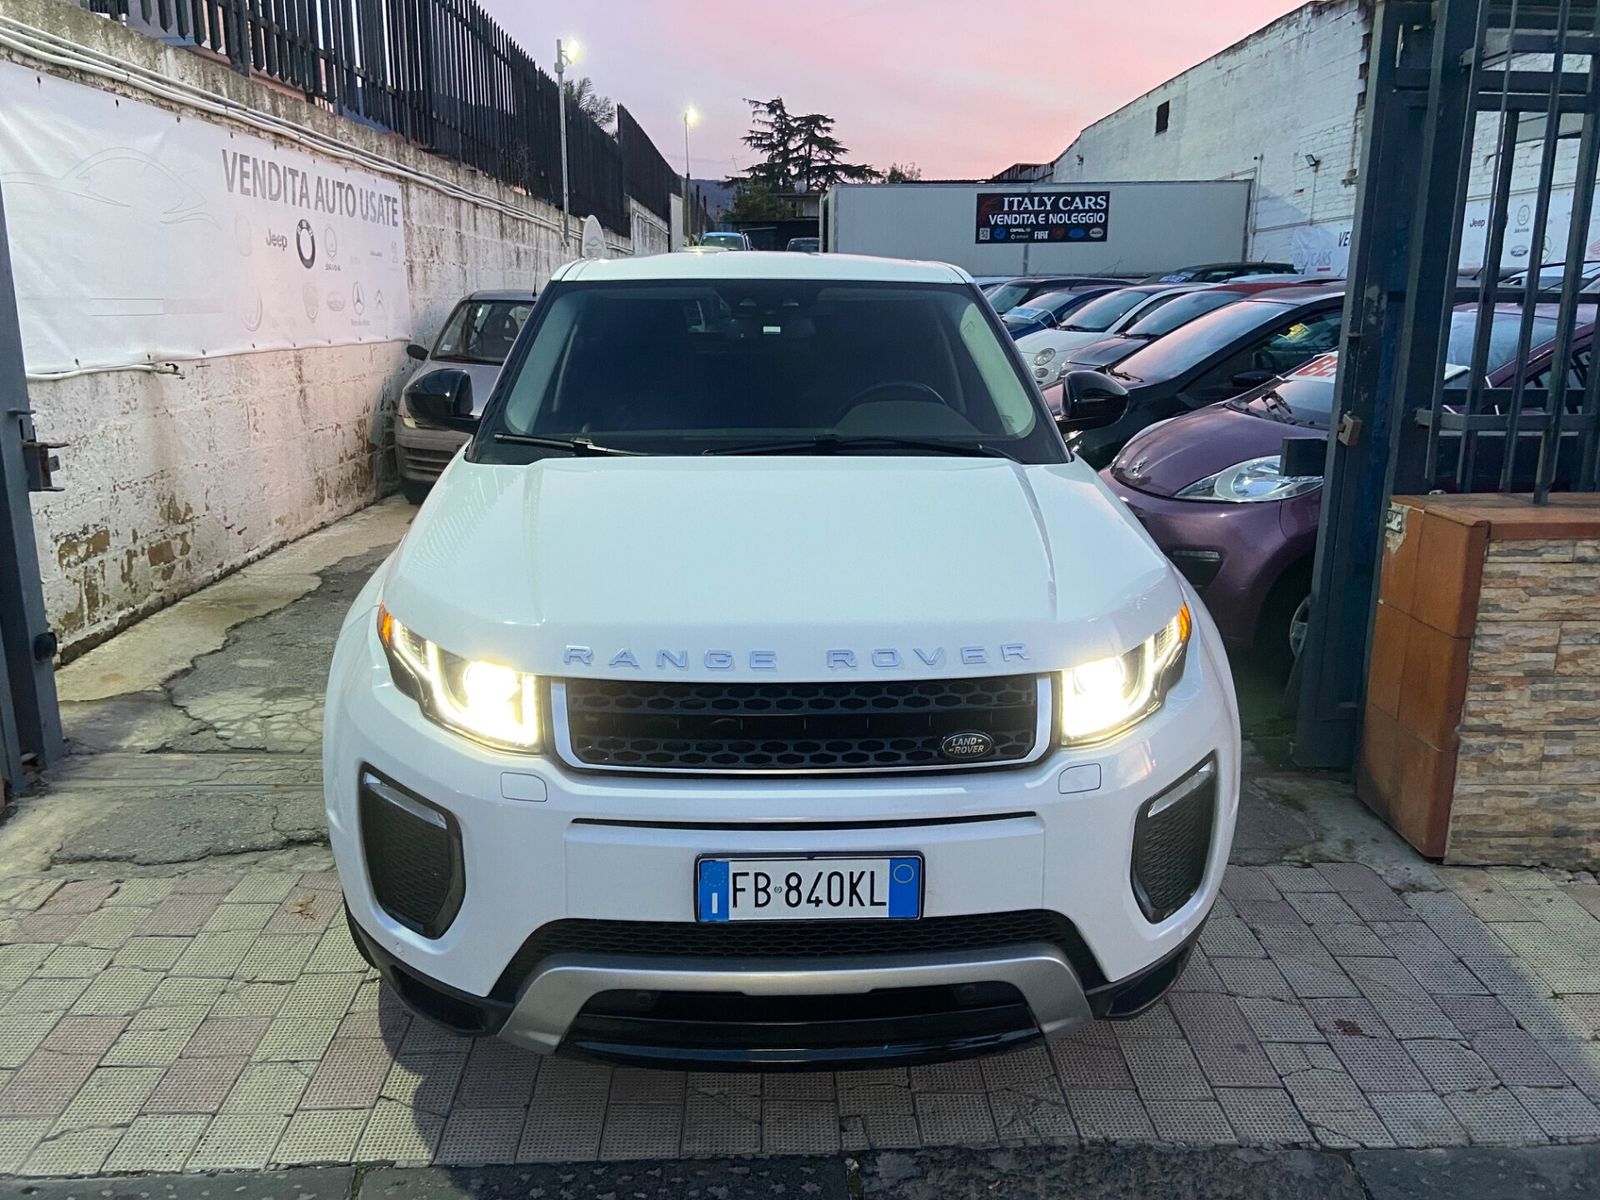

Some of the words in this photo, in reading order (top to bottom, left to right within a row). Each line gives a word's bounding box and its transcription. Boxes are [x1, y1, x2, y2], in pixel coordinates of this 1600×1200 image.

[222, 149, 311, 209] VENDITA
[314, 176, 356, 218] AUTO
[359, 188, 398, 227] USATE
[1003, 196, 1056, 211] ITALY
[1059, 195, 1107, 210] CARS
[989, 213, 1037, 225] VENDITA
[1038, 213, 1046, 224] E
[1049, 212, 1105, 224] NOLEGGIO
[1469, 218, 1486, 228] Jeep
[266, 228, 288, 251] Jeep
[1034, 230, 1049, 240] FIAT
[563, 643, 778, 671] RANGE
[826, 642, 1031, 669] ROVER
[951, 737, 977, 746] LAND
[953, 745, 985, 754] ROVER
